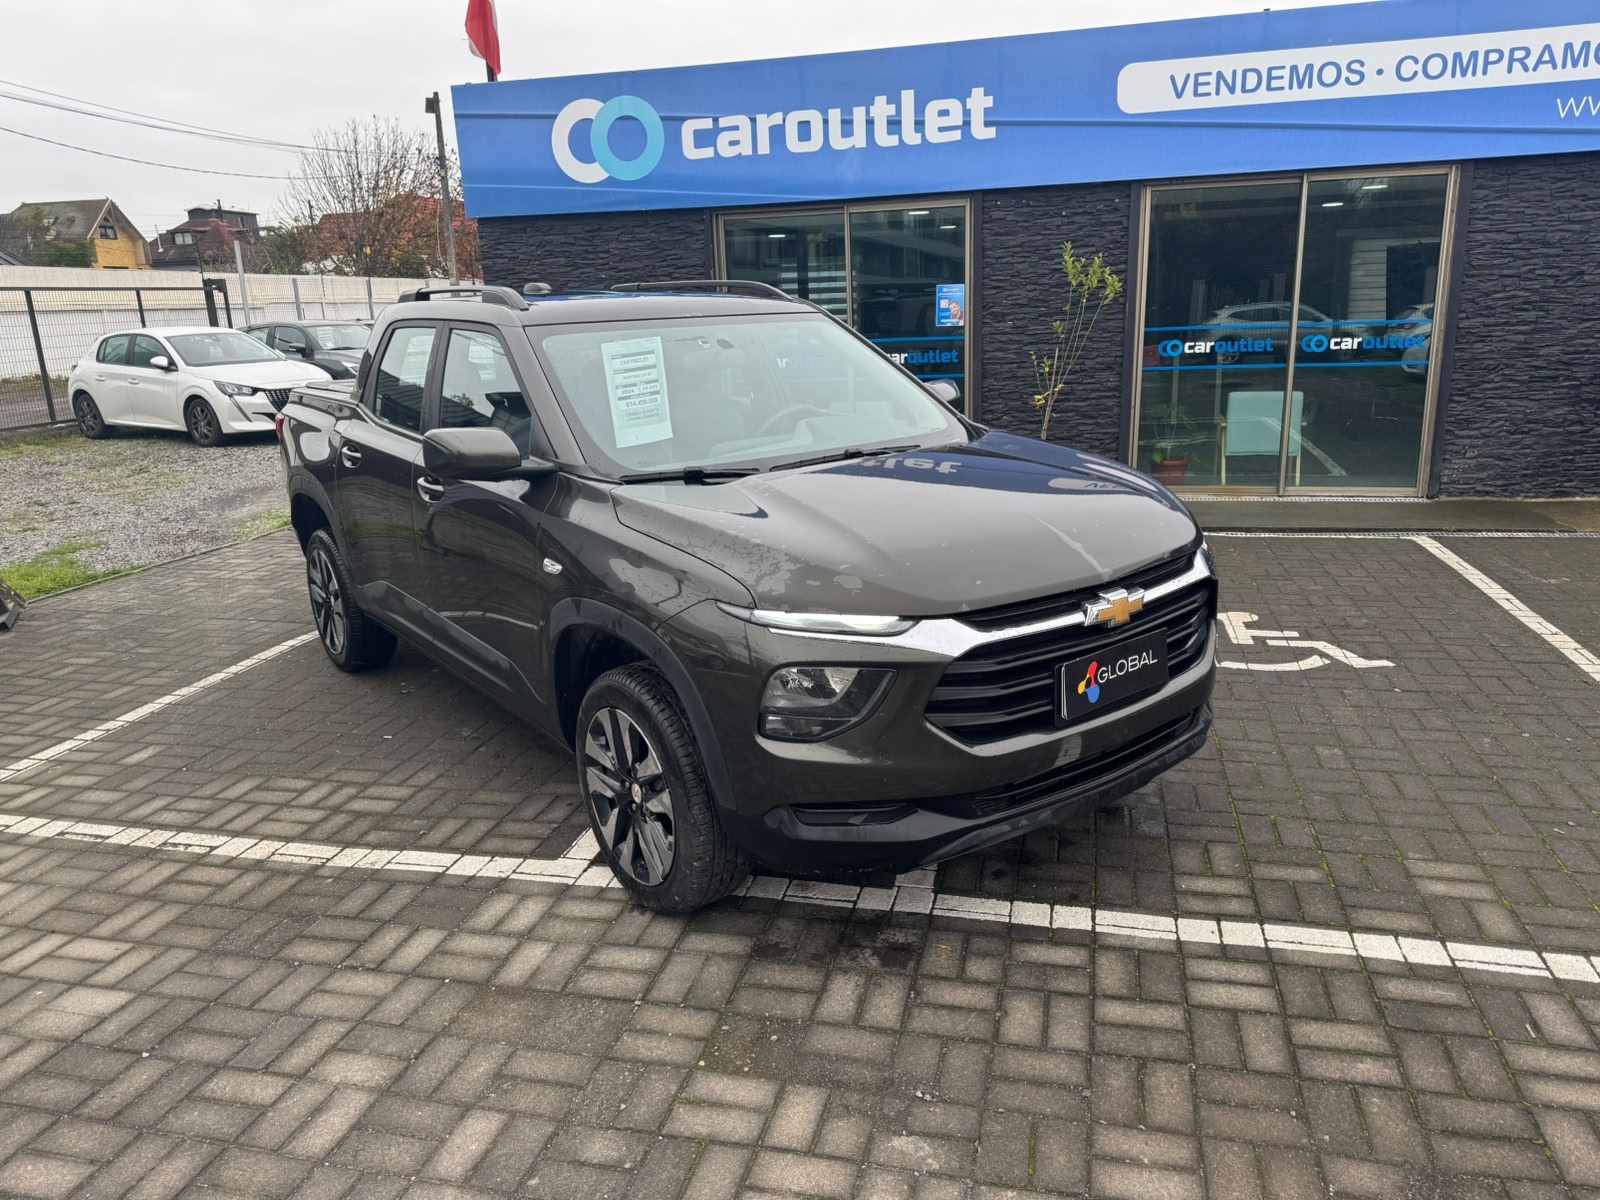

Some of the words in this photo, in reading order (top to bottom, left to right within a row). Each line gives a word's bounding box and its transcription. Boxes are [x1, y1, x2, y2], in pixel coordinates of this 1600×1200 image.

[1169, 59, 1366, 99] VENDEMOS
[1395, 40, 1600, 82] COMPRAM
[681, 87, 996, 160] caroutlet
[1184, 338, 1273, 354] caroutlet
[1329, 334, 1425, 350] caroutlet
[621, 357, 648, 366] CHEVROLET
[1097, 649, 1158, 683] GLOBAL
